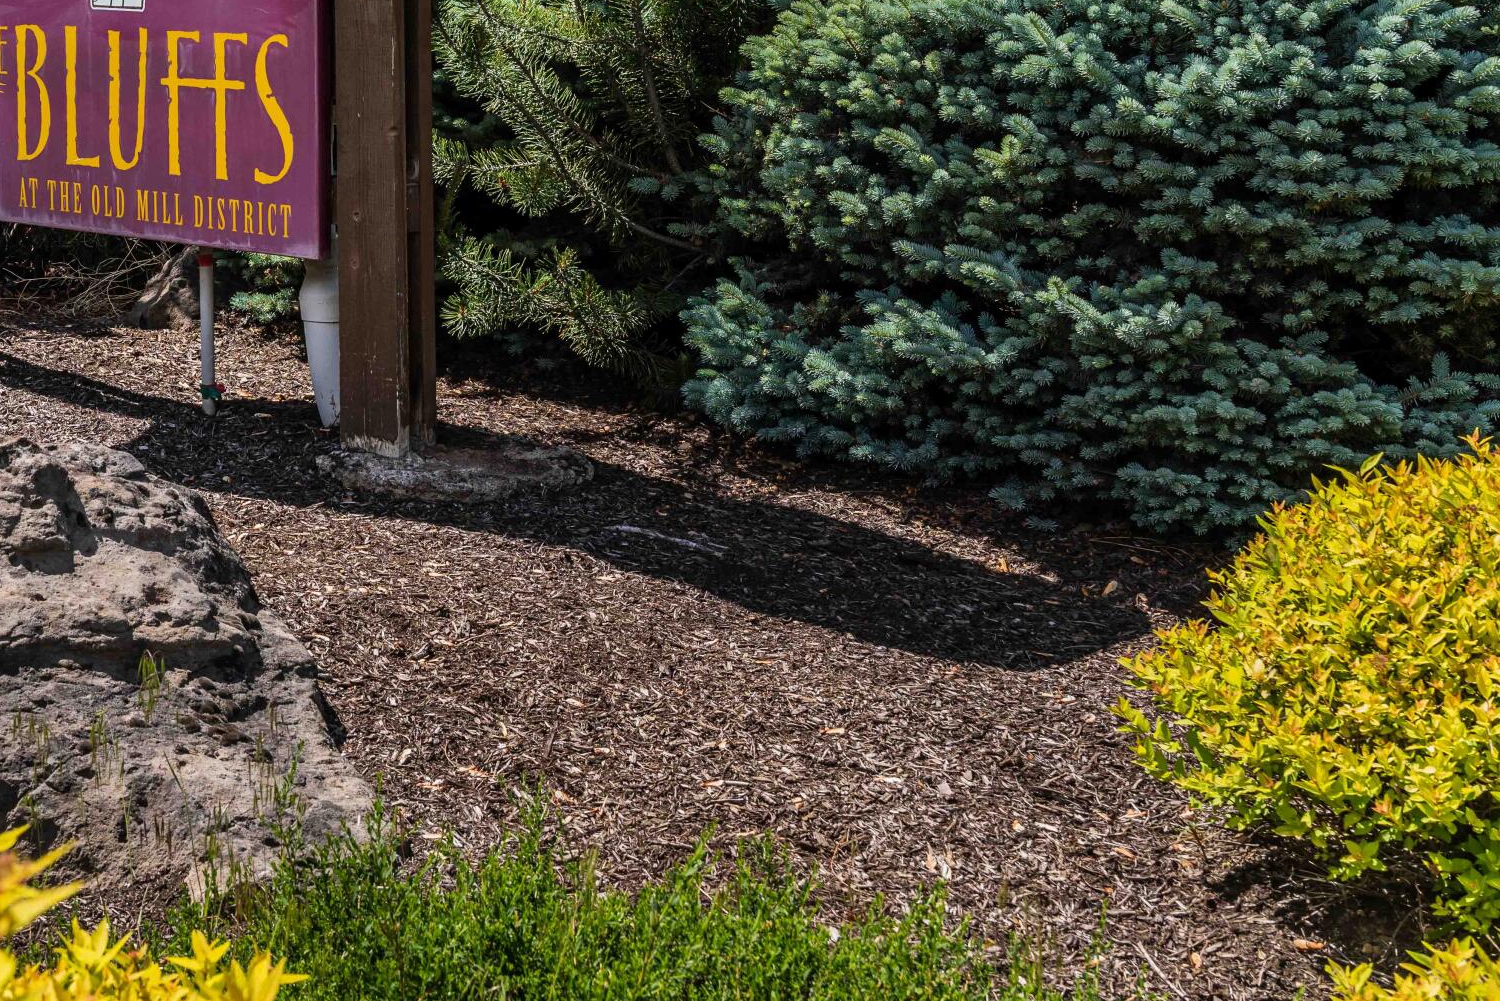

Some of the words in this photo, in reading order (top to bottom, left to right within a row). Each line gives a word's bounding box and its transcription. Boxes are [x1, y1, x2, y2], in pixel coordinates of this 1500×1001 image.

[15, 24, 294, 185] BLUFFS
[19, 176, 39, 210] AT
[47, 178, 82, 214] THE
[91, 185, 125, 219] OLD
[137, 188, 184, 226] MILL
[193, 195, 293, 239] DISTRICT
